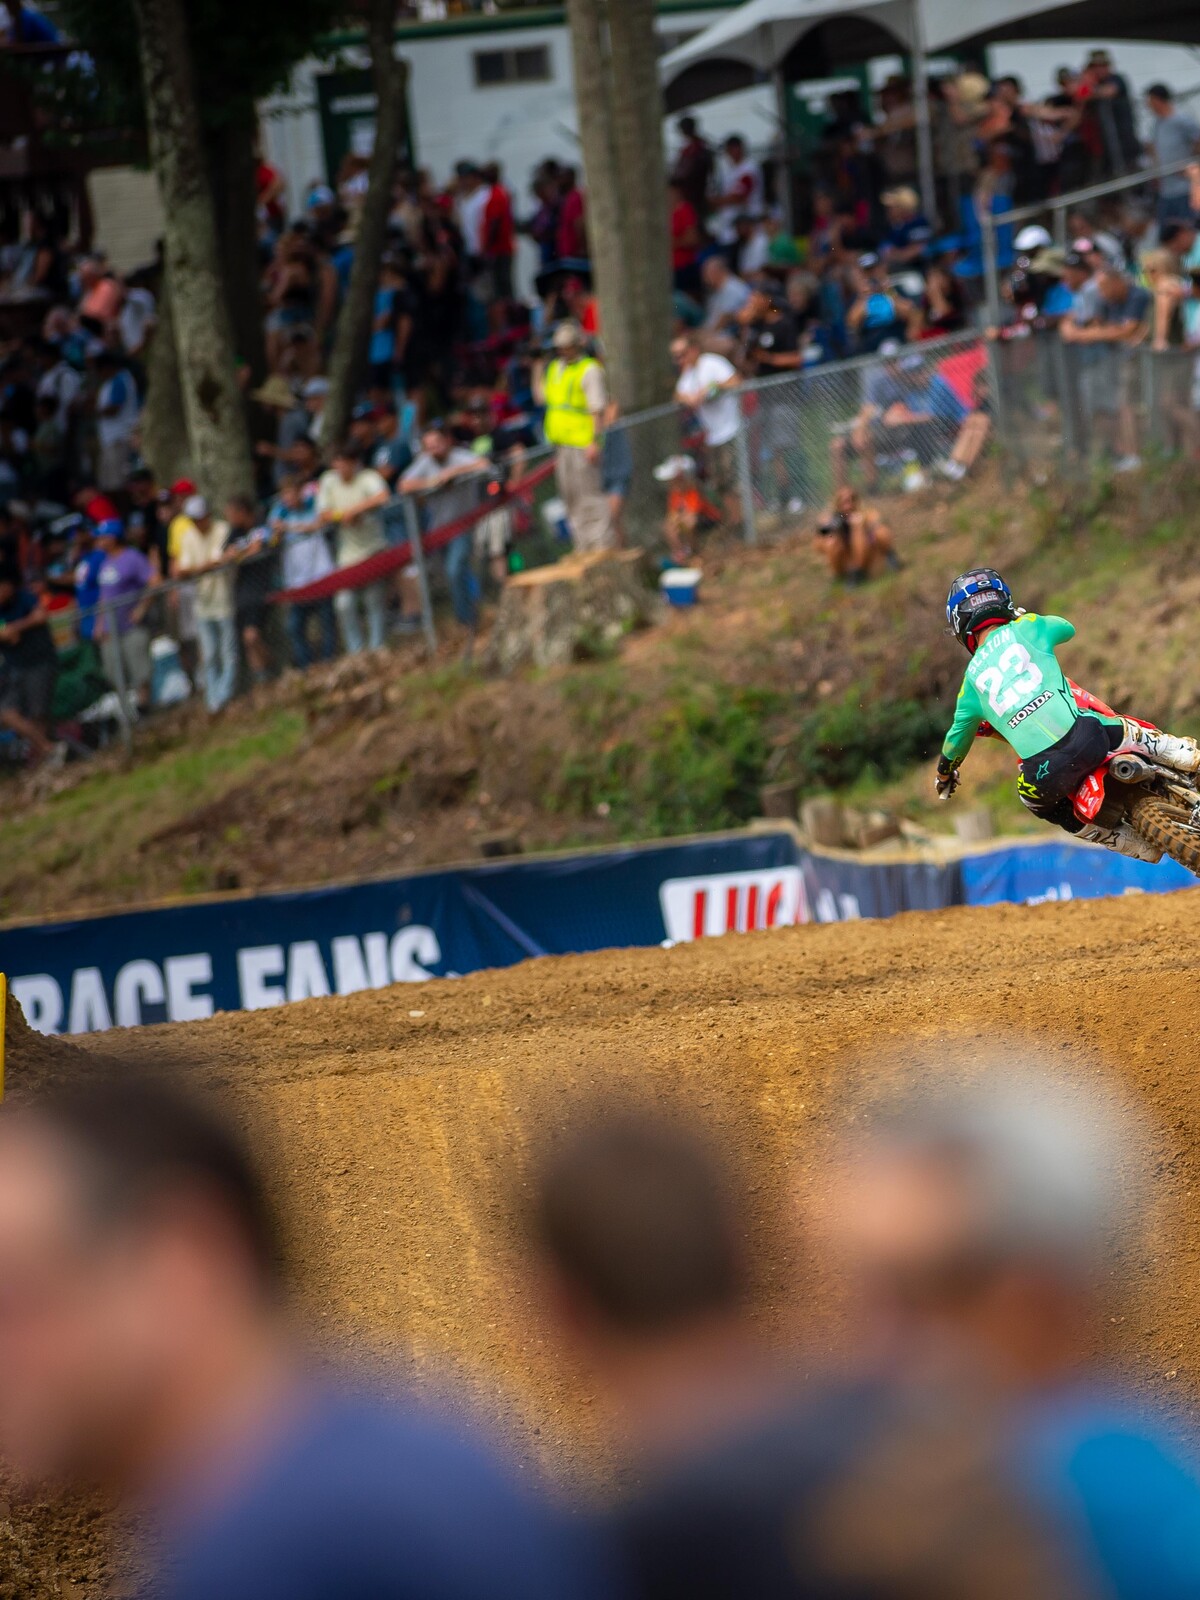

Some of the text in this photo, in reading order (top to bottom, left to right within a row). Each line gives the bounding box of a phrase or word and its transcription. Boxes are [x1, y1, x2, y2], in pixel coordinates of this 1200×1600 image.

[970, 591, 998, 607] CHASE
[967, 627, 1012, 675] SEXTON
[975, 643, 1044, 718] 23
[1007, 690, 1054, 729] HONDA
[8, 925, 444, 1034] RACE FANS
